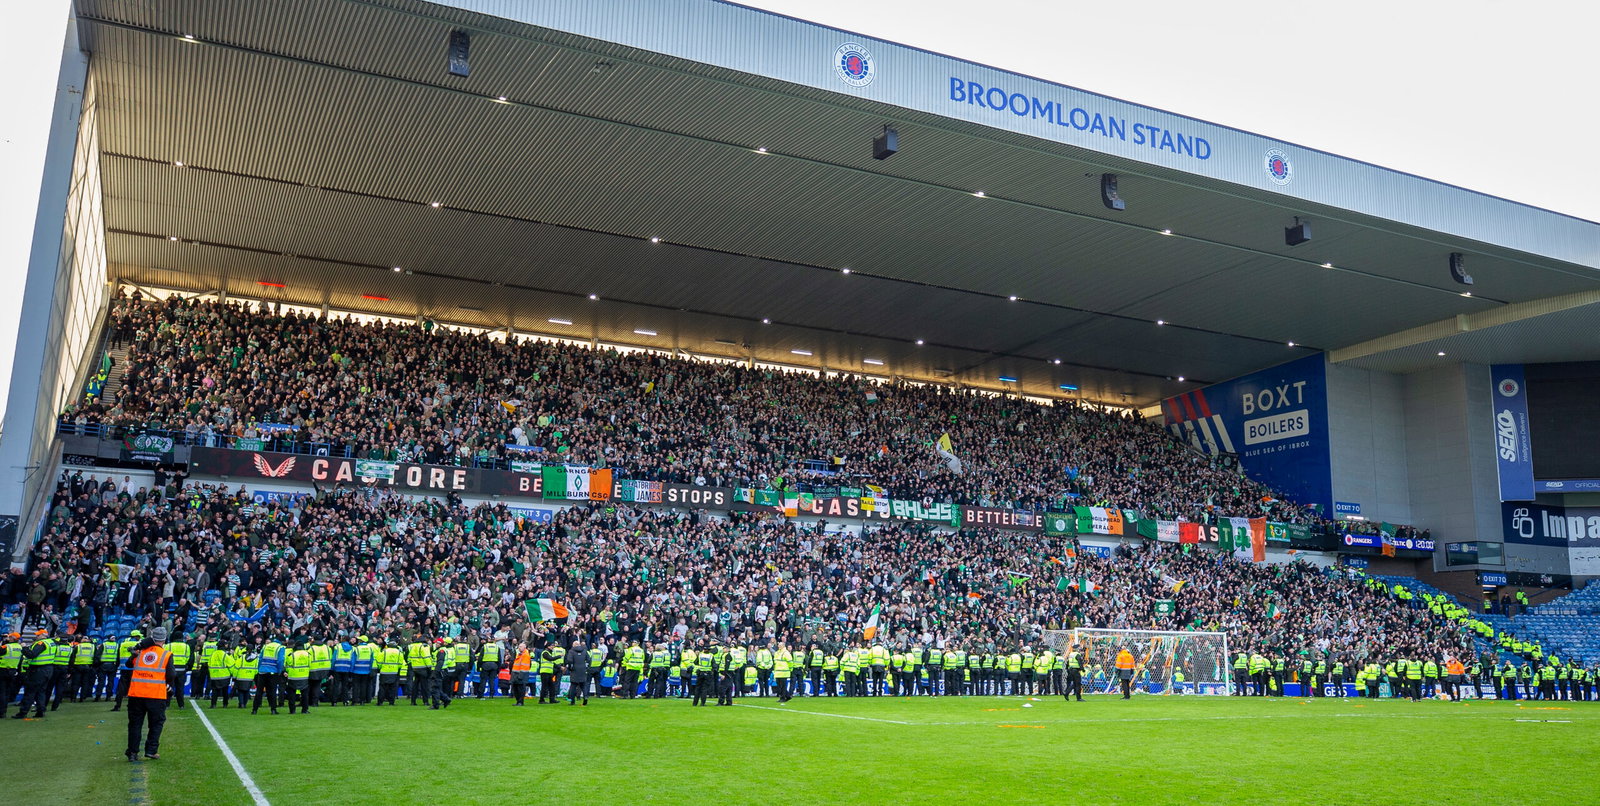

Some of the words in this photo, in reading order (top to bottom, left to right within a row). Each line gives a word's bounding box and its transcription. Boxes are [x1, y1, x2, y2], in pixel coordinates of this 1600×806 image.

[839, 45, 872, 61] RANGERS
[950, 77, 1126, 141] BROOMLOAN
[1133, 123, 1211, 160] STAND
[1243, 381, 1306, 415] BOXT
[1250, 416, 1304, 439] BOILERS
[1497, 409, 1517, 463] SEKO
[1289, 441, 1310, 449] IBROX
[556, 468, 598, 476] GARNGAD
[546, 490, 590, 498] MILLBURN
[637, 491, 661, 501] JAMES
[668, 489, 724, 505] STOPS
